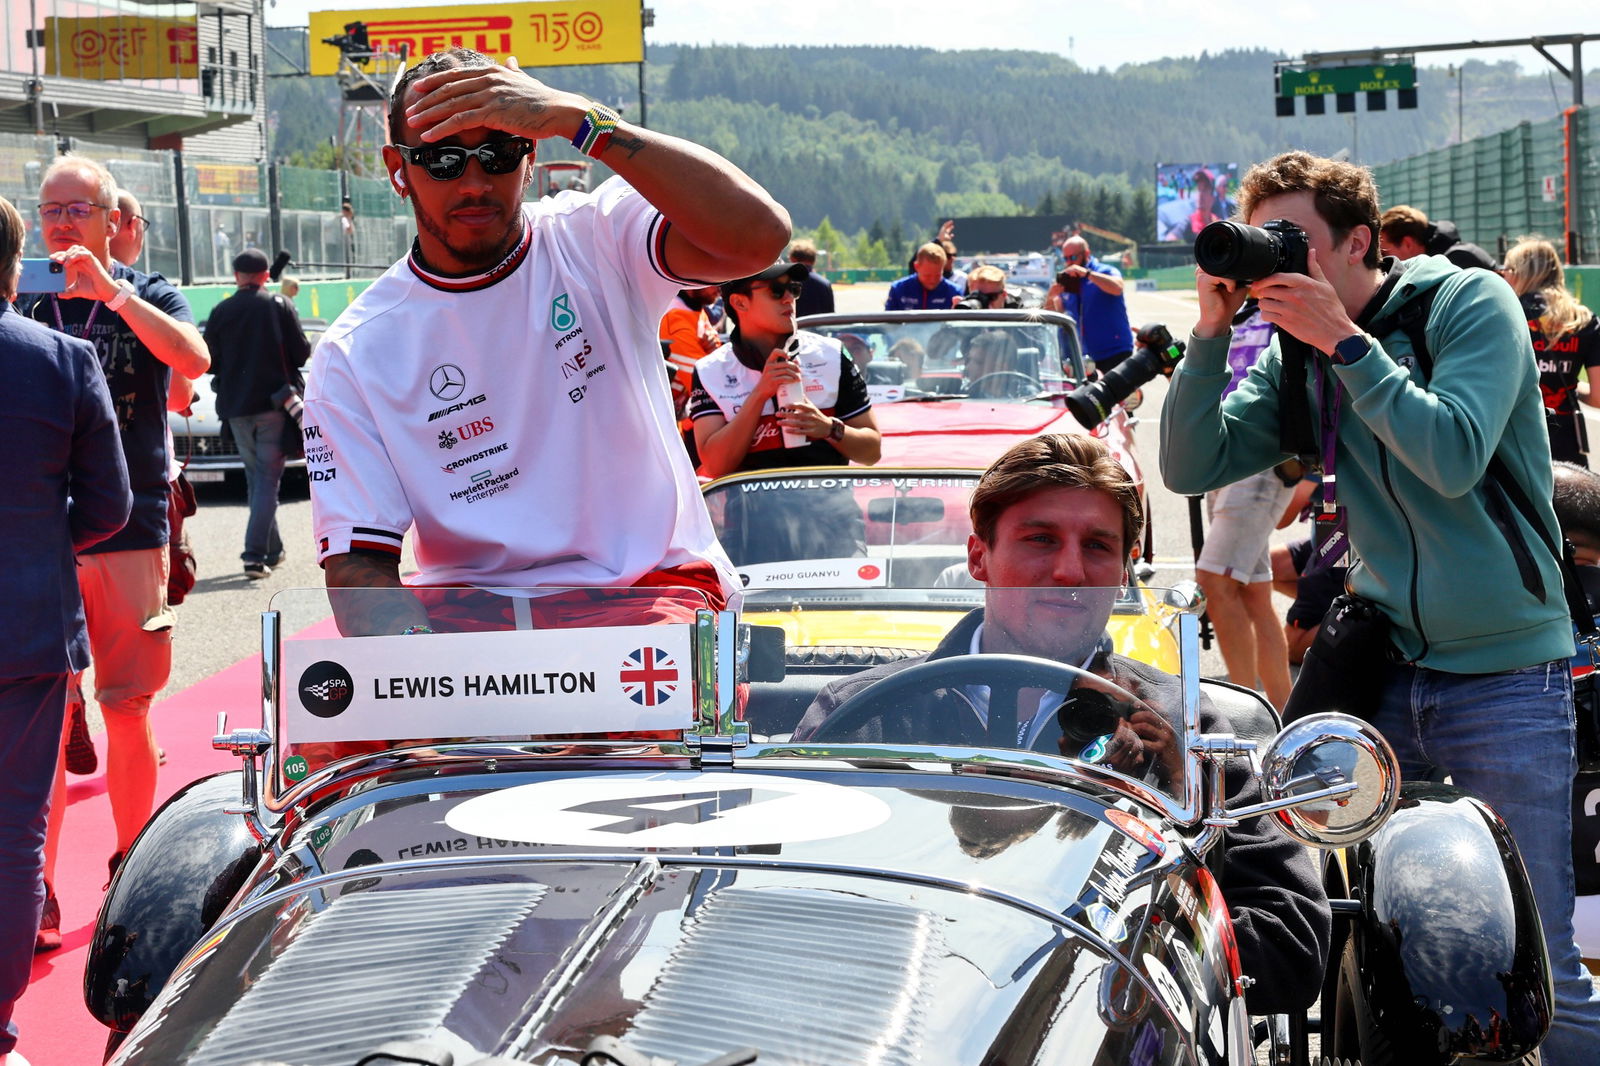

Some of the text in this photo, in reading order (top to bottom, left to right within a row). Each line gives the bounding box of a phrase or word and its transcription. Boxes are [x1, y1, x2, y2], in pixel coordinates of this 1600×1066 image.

[529, 11, 603, 52] 150
[1295, 85, 1335, 94] ROLEX
[1360, 80, 1400, 90] ROLEX
[457, 416, 494, 441] UBS
[446, 442, 509, 471] CROWDSTRIKE
[450, 467, 520, 501] Hewlett Packard
[466, 481, 510, 504] Enterprise
[765, 570, 840, 582] ZHOU GUANYU
[328, 679, 347, 688] SPA
[329, 687, 348, 700] GP
[374, 671, 596, 699] LEWIS HAMILTON
[285, 762, 306, 775] 105
[1157, 971, 1183, 1015] 26
